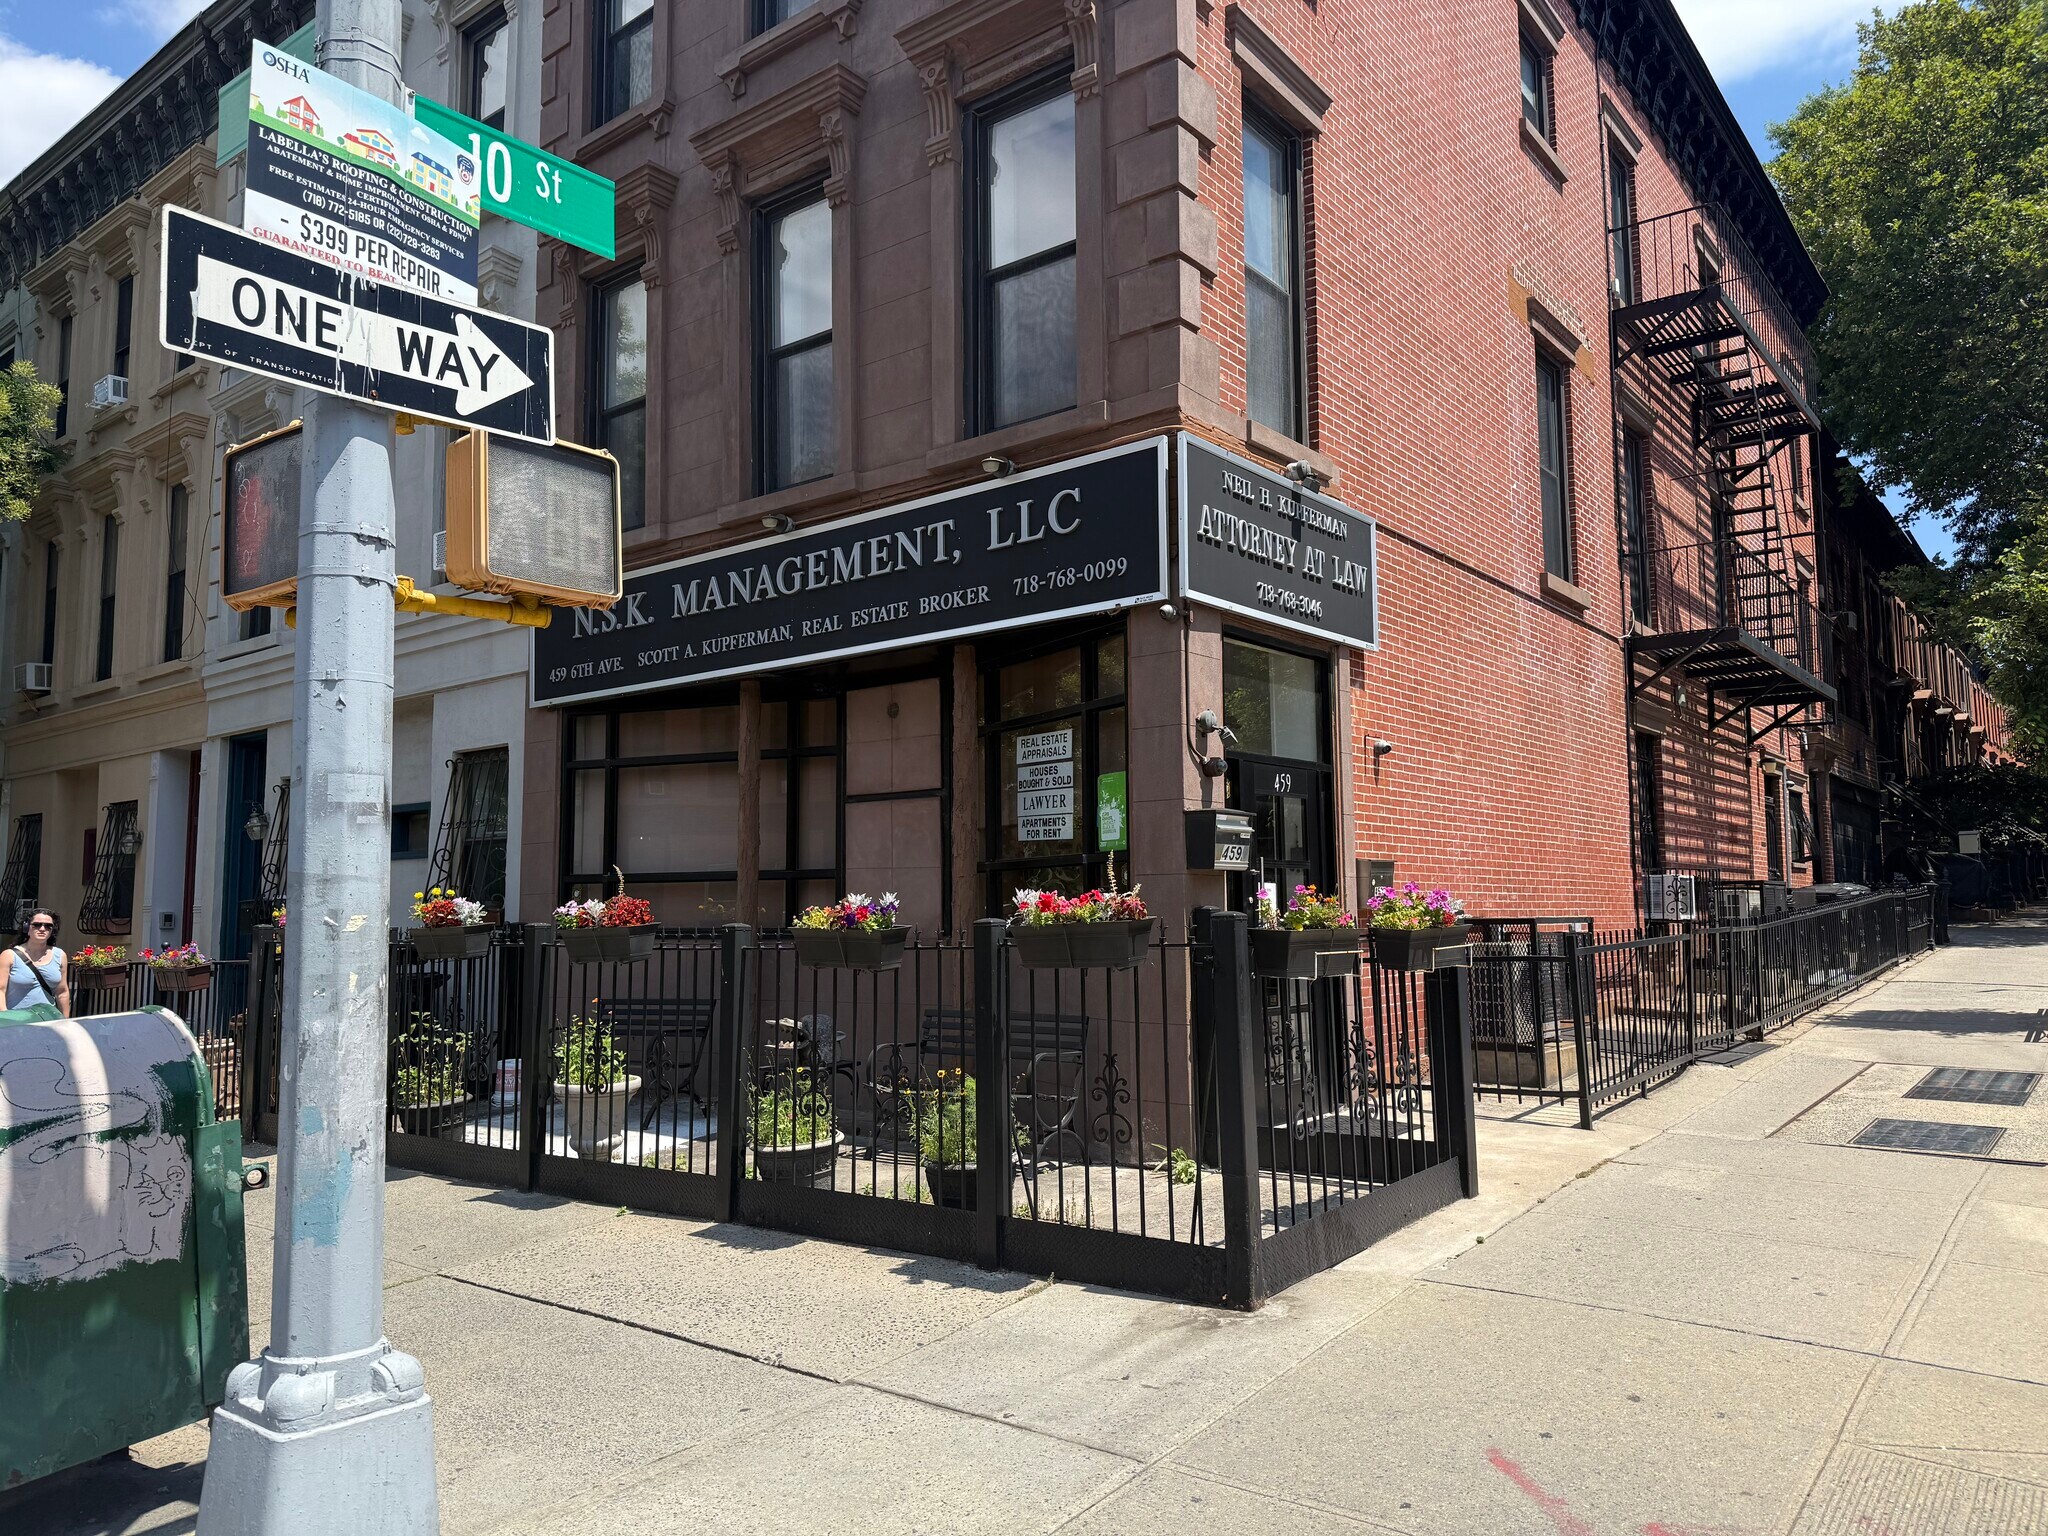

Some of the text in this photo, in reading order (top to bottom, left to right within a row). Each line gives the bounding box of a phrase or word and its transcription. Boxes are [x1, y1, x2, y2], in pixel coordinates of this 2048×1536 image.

[263, 51, 310, 84] OSHA
[258, 126, 473, 237] LABELLA'S ROOFING & CONSTRUCTION
[266, 144, 467, 243] ABATEMENT & HOME IMPROVEMENT OSHA & FDNY
[536, 161, 562, 204] St
[269, 164, 465, 260] FREE ESTIMATES 24-HOUR EMERGENCY SERVICES
[303, 189, 326, 210] (718)
[328, 199, 371, 226] 772-5185
[373, 217, 385, 231] OR
[356, 191, 400, 215] CERTIFIED
[253, 226, 396, 283] GUARANTEED TO BEAT
[300, 213, 348, 255] $399
[355, 235, 388, 269] PER
[392, 249, 440, 296] REPAIR
[232, 277, 500, 392] ONE WAY
[224, 349, 238, 357] OF
[250, 356, 340, 386] TRANSPORTATION
[1222, 470, 1348, 539] NEIL H. KUPFERMAN
[572, 487, 1082, 639] N.S.K. MANAGEMENT, LLC
[1197, 504, 1368, 593] ATTORNEY AT LAW
[1256, 581, 1323, 617] 718-768-3046
[549, 557, 1128, 683] 459 6TH AVE. SCOTT A. KUPFERMAN, REAL ESTATE BROKER 718-768-0099
[1020, 733, 1068, 749] REAL ESTATE
[1021, 745, 1067, 760] APPRAISALS
[1018, 775, 1072, 790] BOUGHT & SOLD
[1029, 765, 1058, 778] HOUSES
[1274, 773, 1292, 793] 459
[1023, 794, 1067, 811] LAWYER
[1021, 816, 1066, 829] APARTMENTS
[1026, 828, 1062, 839] FOR RENT
[1221, 845, 1242, 861] 459
